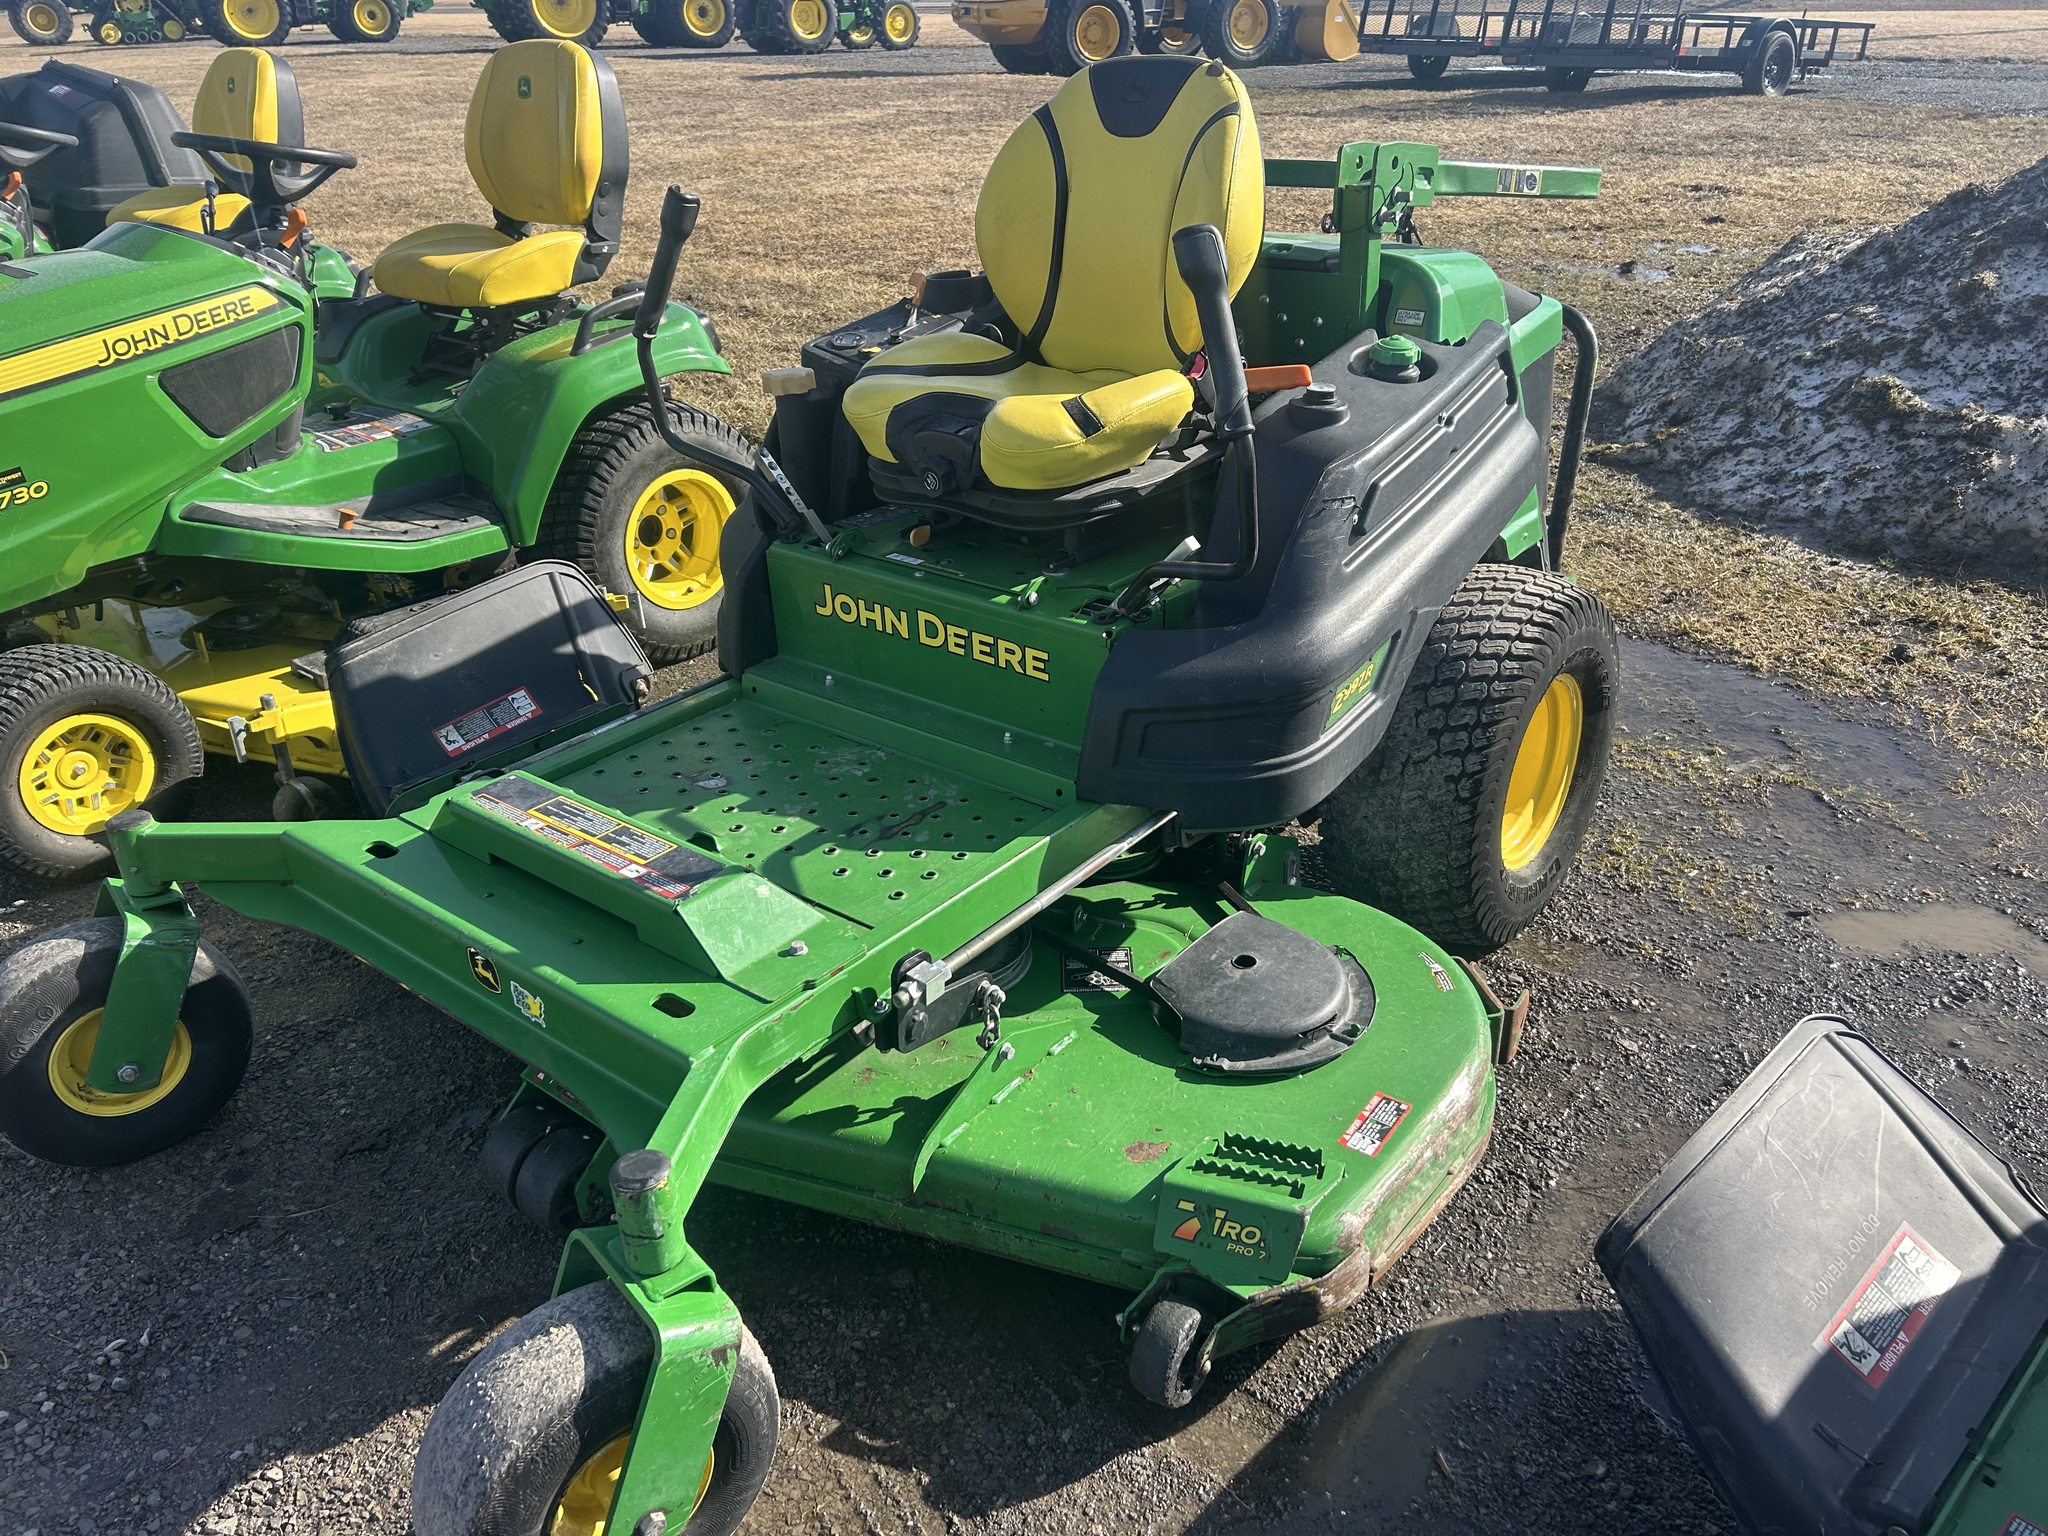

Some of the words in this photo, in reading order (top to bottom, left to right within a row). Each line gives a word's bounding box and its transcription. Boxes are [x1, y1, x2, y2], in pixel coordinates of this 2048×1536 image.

[98, 324, 170, 364] JOHN
[172, 296, 255, 337] DEERE
[815, 583, 910, 640] JOHN
[916, 608, 1050, 683] DEERE
[1861, 1213, 1880, 1235] DO
[1226, 1242, 1254, 1256] PRO
[1840, 1231, 1867, 1260] NOT
[1802, 1259, 1848, 1312] REMOVE
[1879, 1337, 1906, 1372] PELIGRO
